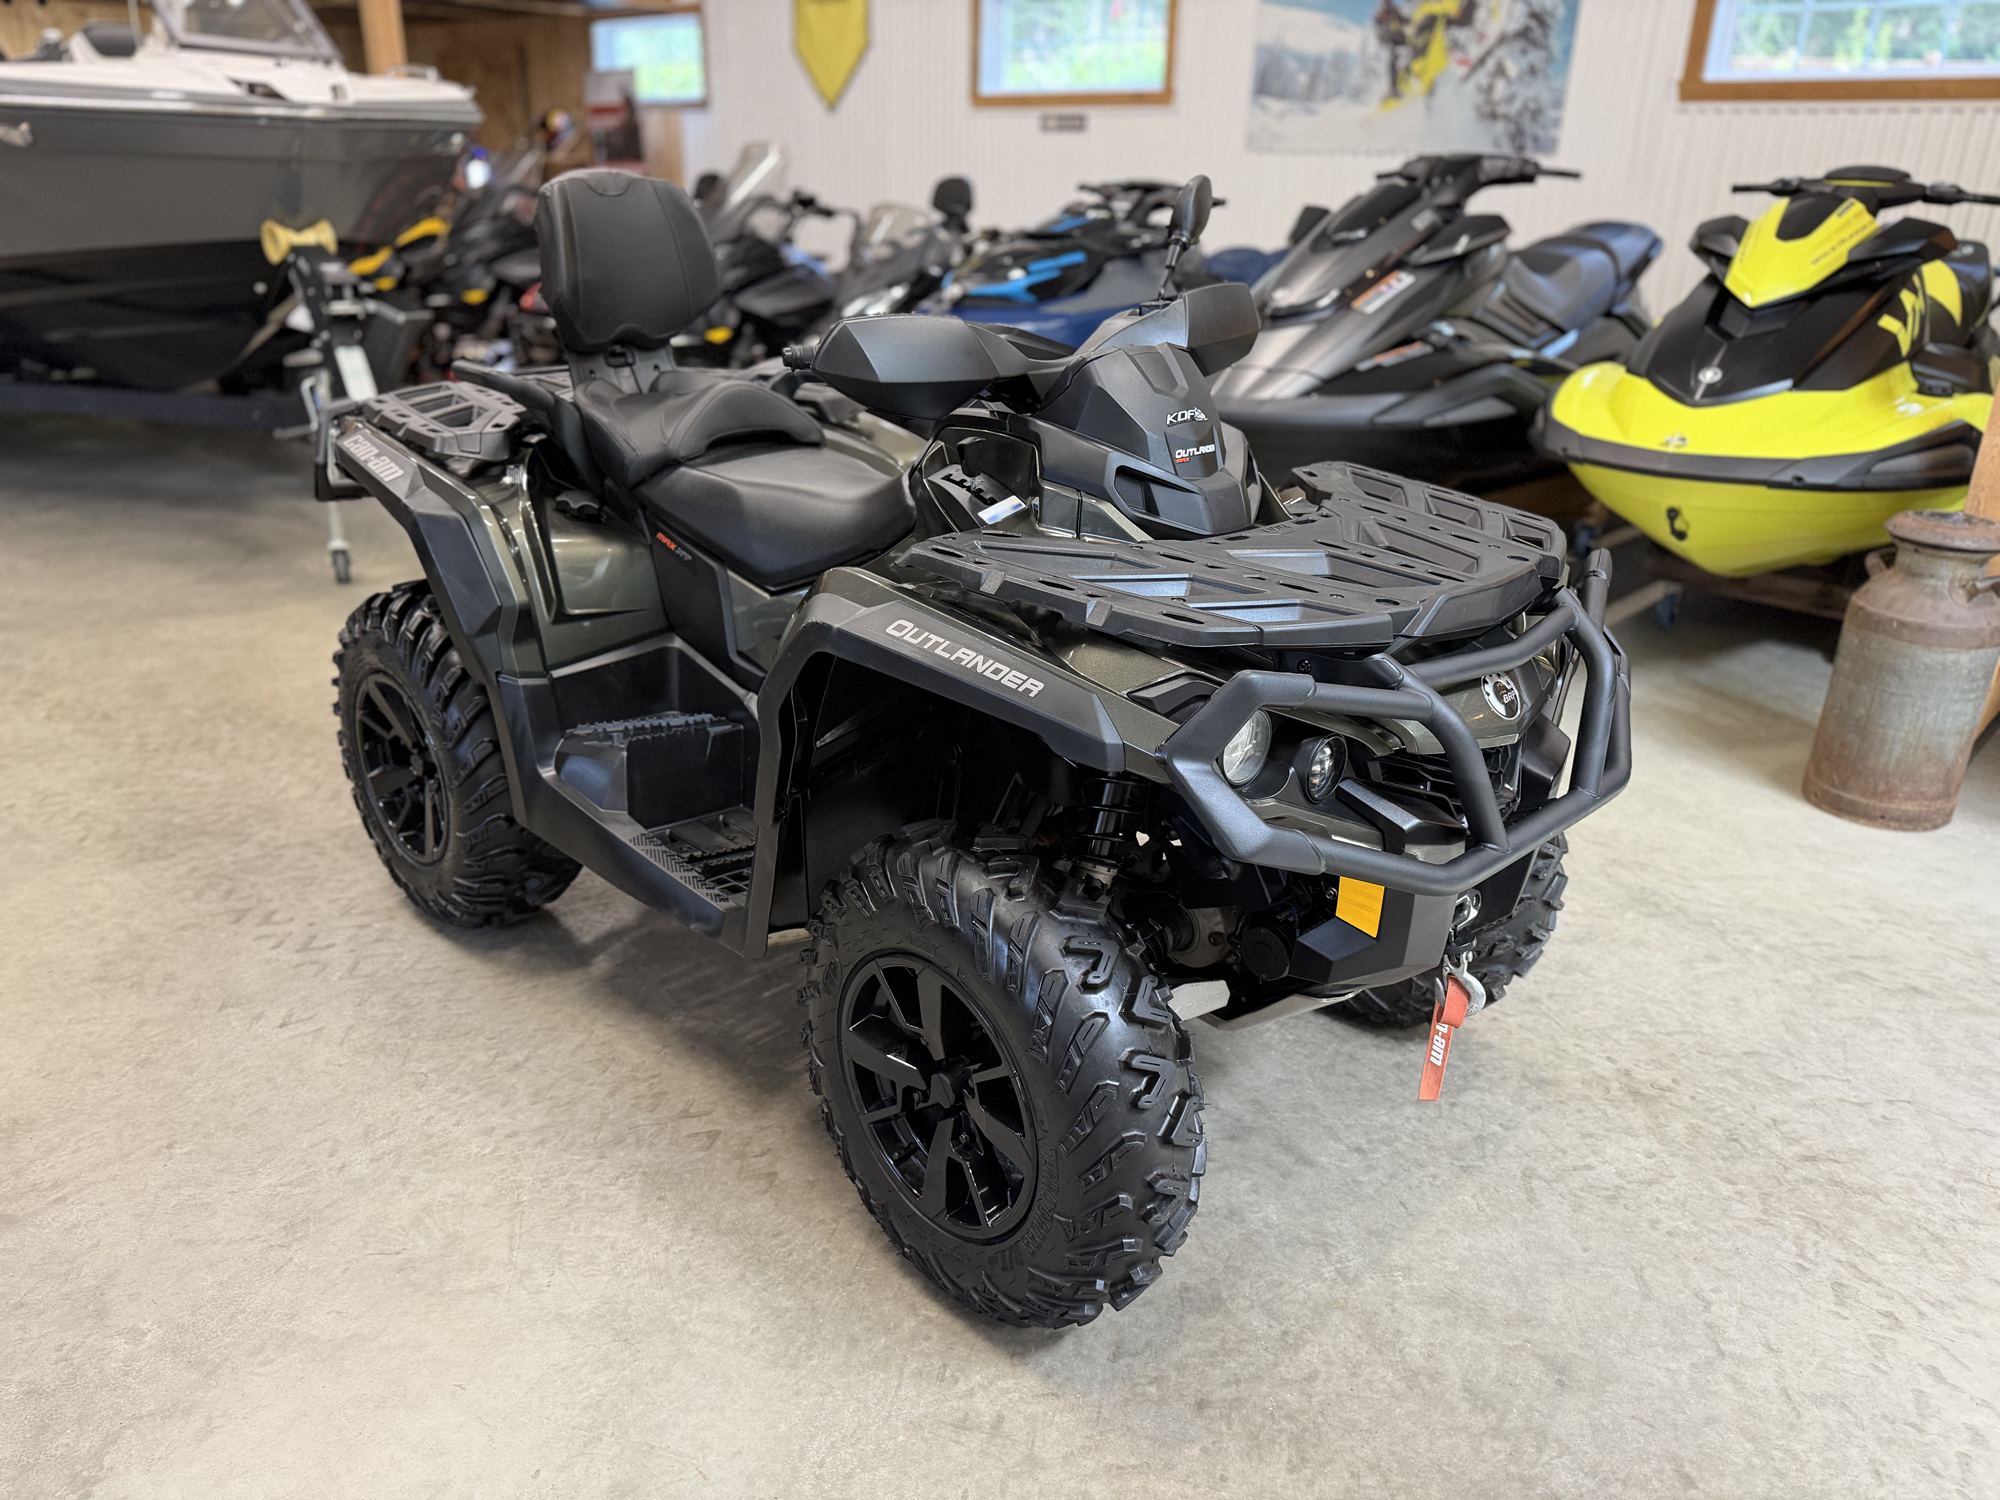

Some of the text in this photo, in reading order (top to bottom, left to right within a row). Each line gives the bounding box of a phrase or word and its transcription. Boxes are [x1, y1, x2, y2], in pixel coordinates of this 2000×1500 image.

[1166, 410, 1196, 425] KDF
[343, 434, 404, 482] can-am
[656, 532, 677, 551] MAX
[885, 619, 1045, 698] OUTLANDER
[1503, 691, 1516, 704] BRP
